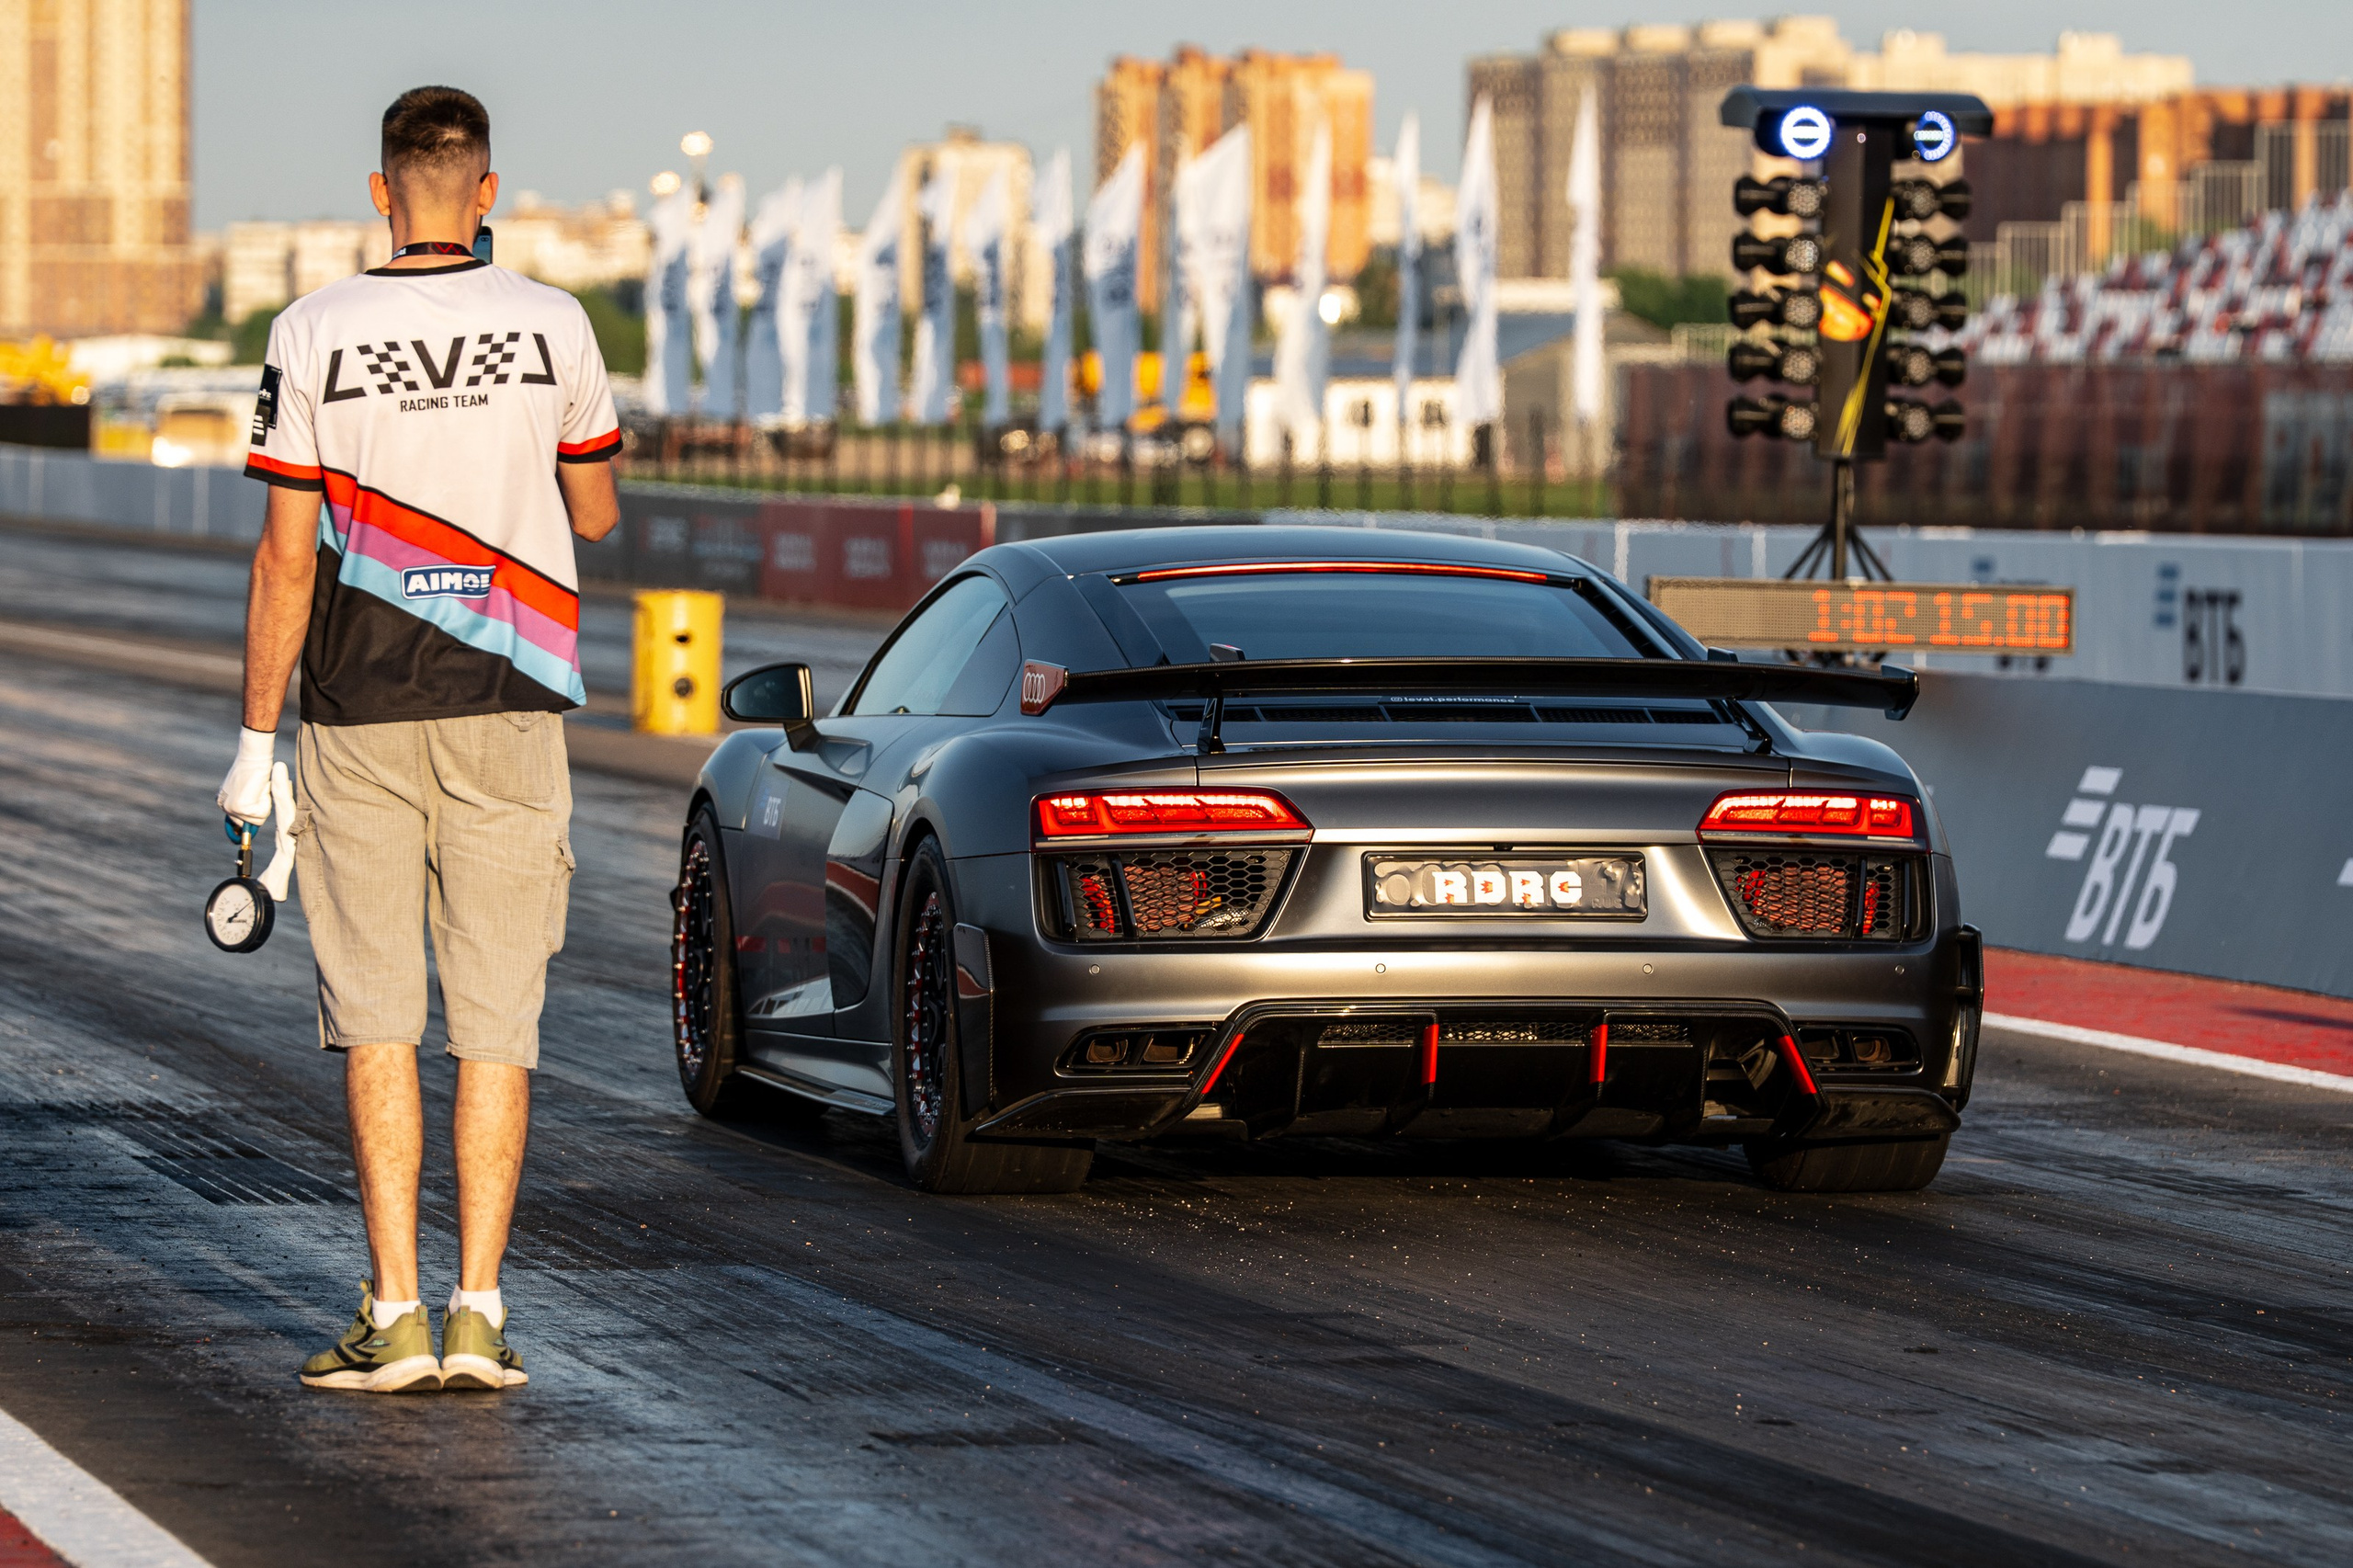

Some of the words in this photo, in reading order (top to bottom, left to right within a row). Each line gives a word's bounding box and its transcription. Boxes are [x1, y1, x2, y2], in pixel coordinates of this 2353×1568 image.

[400, 395, 449, 413] RACING
[453, 393, 489, 407] TEAM
[2183, 587, 2245, 686] ВТБ
[2064, 802, 2201, 950] ВТБ
